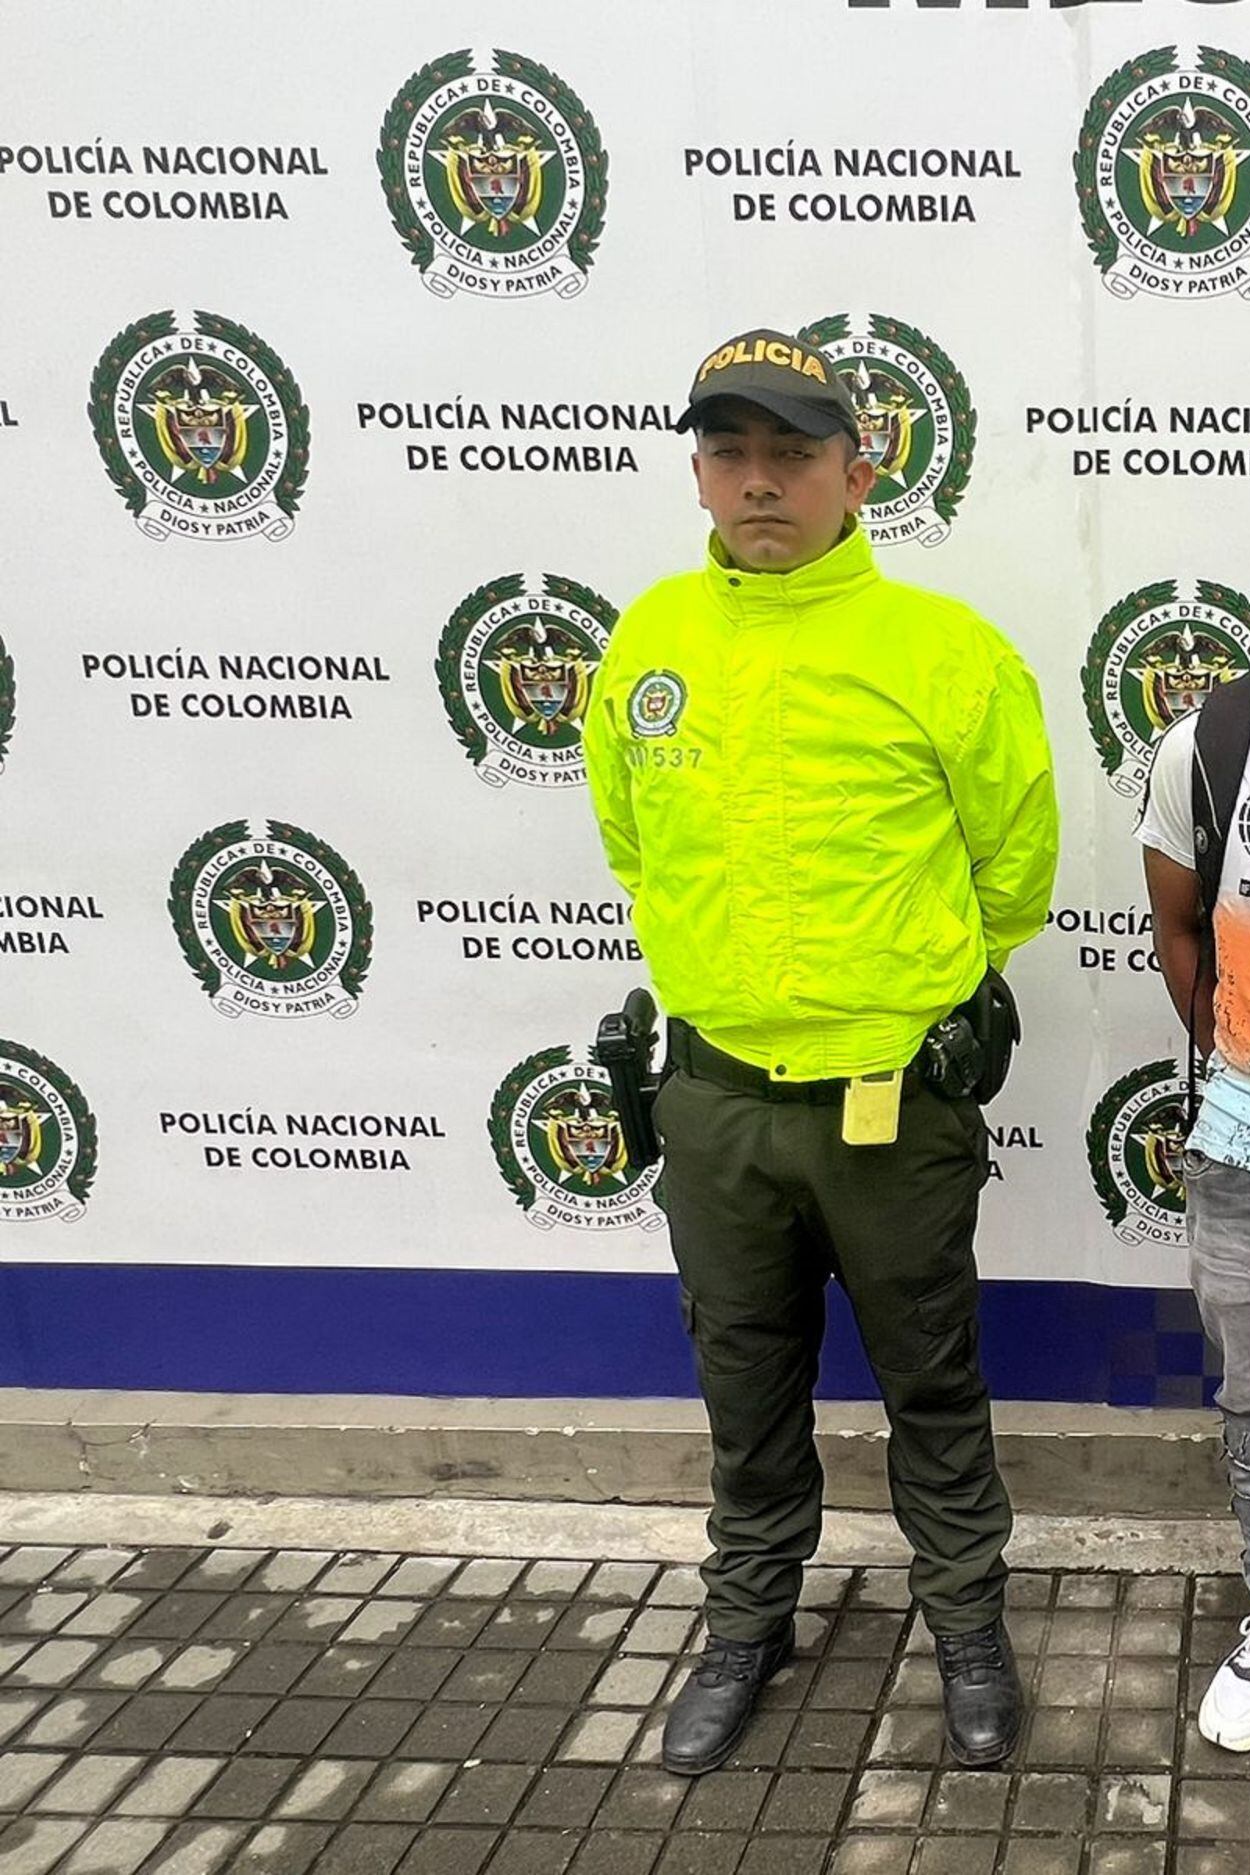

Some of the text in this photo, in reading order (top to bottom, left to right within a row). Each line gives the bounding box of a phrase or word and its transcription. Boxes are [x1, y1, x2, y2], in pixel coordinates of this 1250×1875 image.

[1179, 75, 1203, 90] DE
[476, 78, 500, 92] DE
[520, 90, 581, 189] COLOMBIA
[0, 136, 328, 175] POLICÍA NACIONAL
[684, 139, 1021, 178] POLICÍA NACIONAL
[47, 191, 289, 220] DE COLOMBIA
[733, 193, 976, 222] DE COLOMBIA
[503, 211, 576, 268] NACIONAL
[505, 265, 562, 292] PATRIA
[1188, 266, 1248, 293] PATRIA
[699, 339, 827, 384] POLICIA
[180, 337, 203, 351] DE
[223, 349, 284, 441] COLOMBIA
[852, 341, 949, 445] DE COLOMBIA
[357, 395, 676, 432] POLICÍA NACIONAL
[1026, 397, 1157, 434] POLICÍA
[406, 445, 639, 473] DE COLOMBIA
[1073, 449, 1110, 476] DE
[213, 461, 281, 514] NACIONAL
[870, 466, 943, 519] NACIONAL
[216, 511, 270, 535] PATRIA
[870, 516, 926, 541] PATRIA
[528, 598, 550, 611] DE
[1179, 605, 1201, 618] DE
[82, 647, 390, 681] POLICÍA NACIONAL
[130, 693, 353, 720] DE COLOMBIA
[253, 843, 275, 854] DE
[293, 853, 349, 932] COLOMBIA
[417, 893, 541, 924] POLICÍA
[462, 936, 643, 961] DE COLOMB
[1079, 945, 1116, 972] DE
[283, 950, 346, 995] NACIONAL
[285, 992, 336, 1013] PATRIA
[574, 1067, 595, 1078] DE
[17, 1068, 74, 1142] COLOMBIA
[159, 1107, 446, 1138] POLICÍA NACIONAL
[204, 1146, 411, 1171] DE COLOMBIA
[13, 1158, 72, 1200] NACIONAL
[595, 1167, 659, 1209] NACIONAL
[16, 1197, 64, 1217] PATRIA
[597, 1207, 646, 1227] PATRIA
